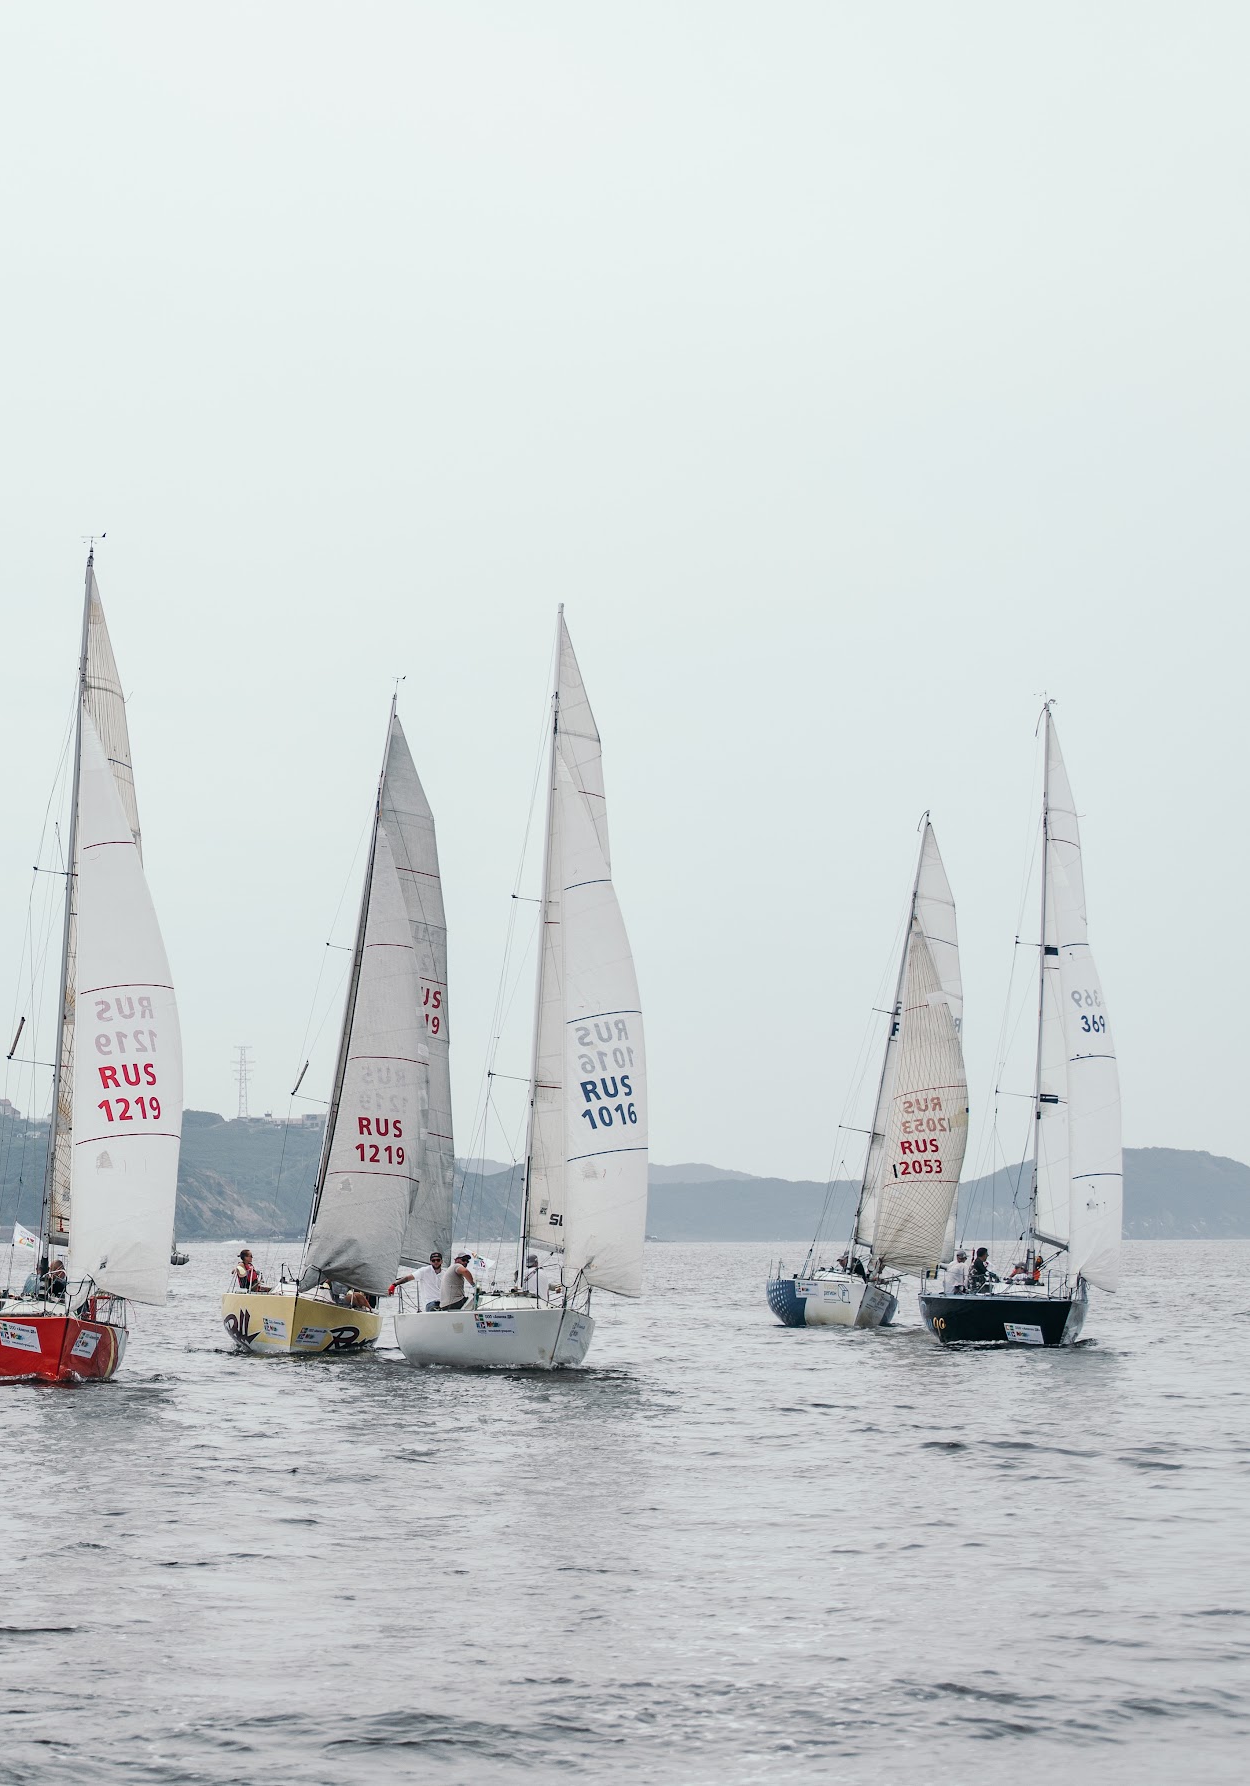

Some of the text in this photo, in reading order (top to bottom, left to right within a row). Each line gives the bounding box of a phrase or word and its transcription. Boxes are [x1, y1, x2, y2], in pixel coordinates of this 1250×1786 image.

[424, 1013, 440, 1035] 9
[1080, 1014, 1106, 1034] 369
[97, 1063, 157, 1089] RUS
[579, 1074, 634, 1103] RUS
[97, 1096, 162, 1122] 1219
[581, 1102, 638, 1130] 1016
[357, 1116, 403, 1139] RUS
[355, 1143, 405, 1166] 1219
[900, 1138, 940, 1155] RUS
